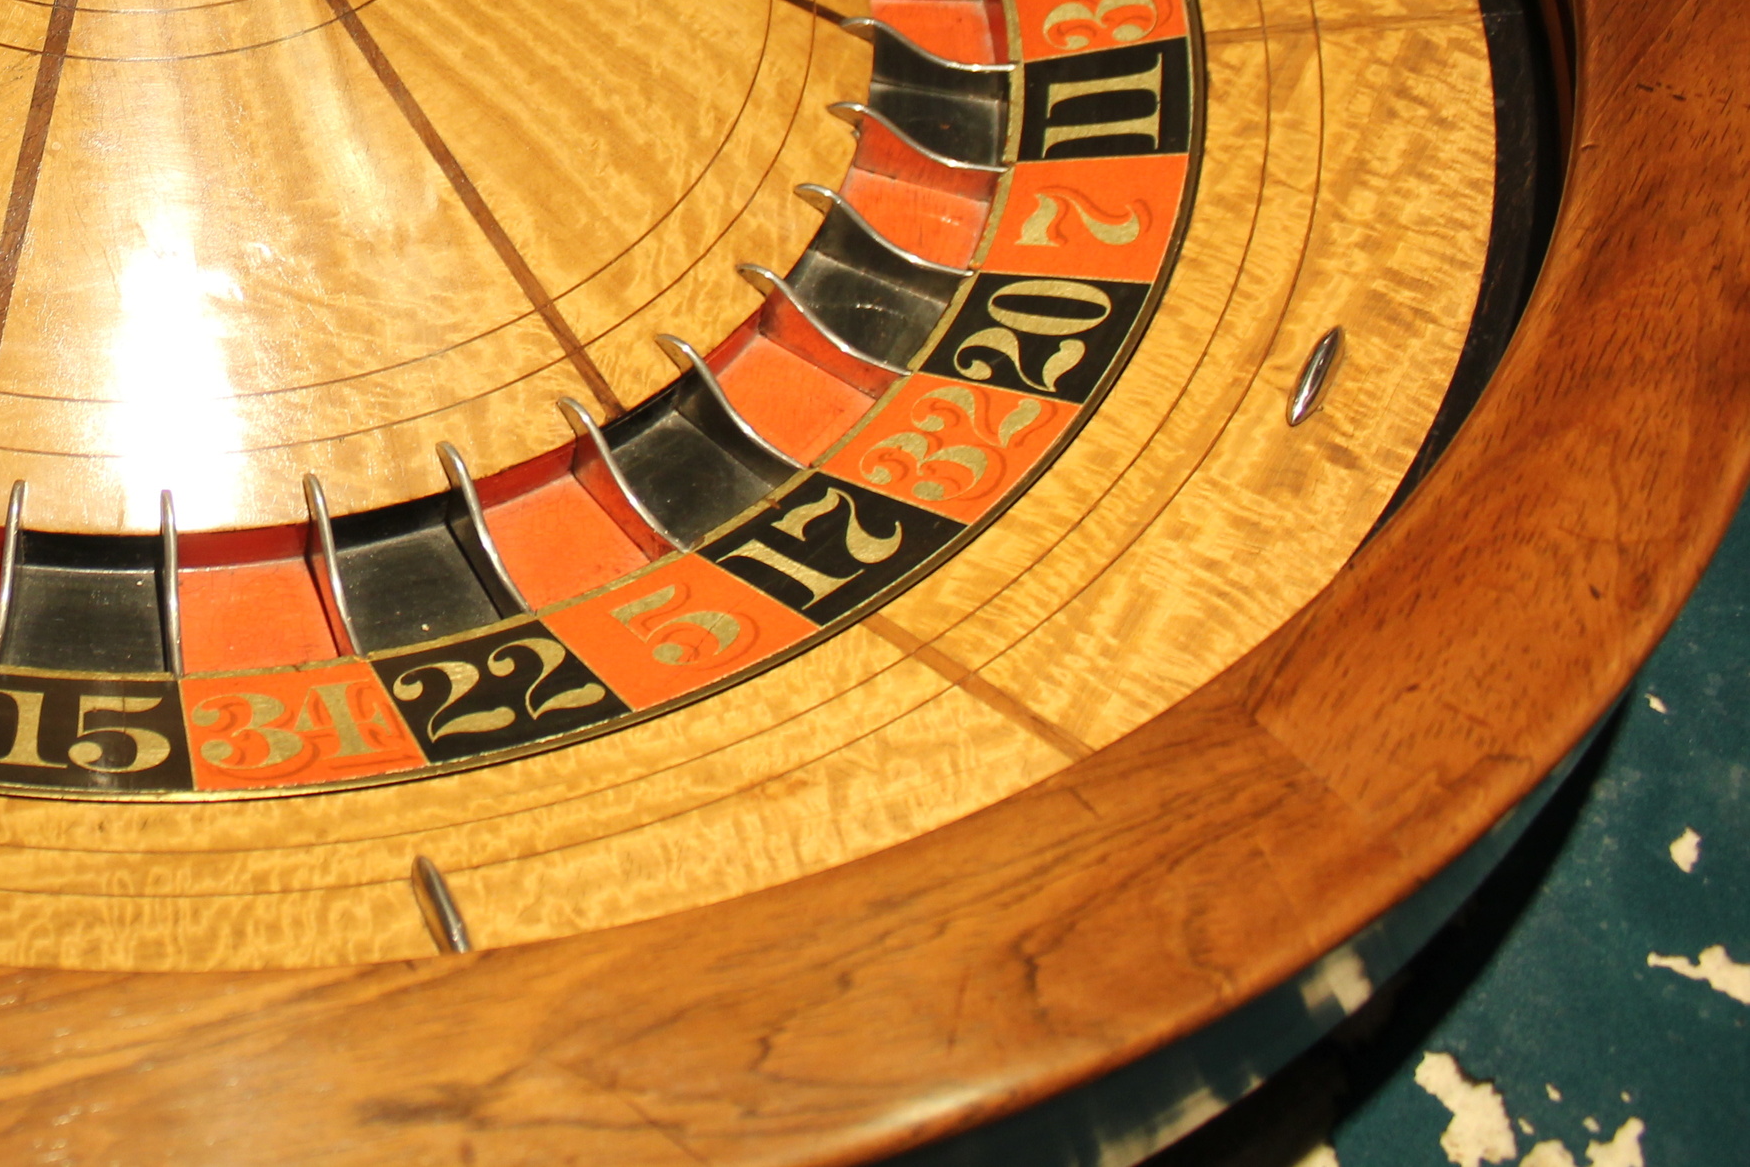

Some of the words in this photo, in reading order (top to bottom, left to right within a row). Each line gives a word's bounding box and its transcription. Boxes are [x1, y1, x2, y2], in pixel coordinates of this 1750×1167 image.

[1043, 52, 1163, 158] 11
[1015, 193, 1140, 247] 7
[954, 279, 1112, 392] 20
[860, 387, 1041, 501] 32
[715, 487, 902, 610] 17
[609, 585, 741, 666] 5
[192, 681, 390, 769] 34
[392, 637, 605, 743] 22
